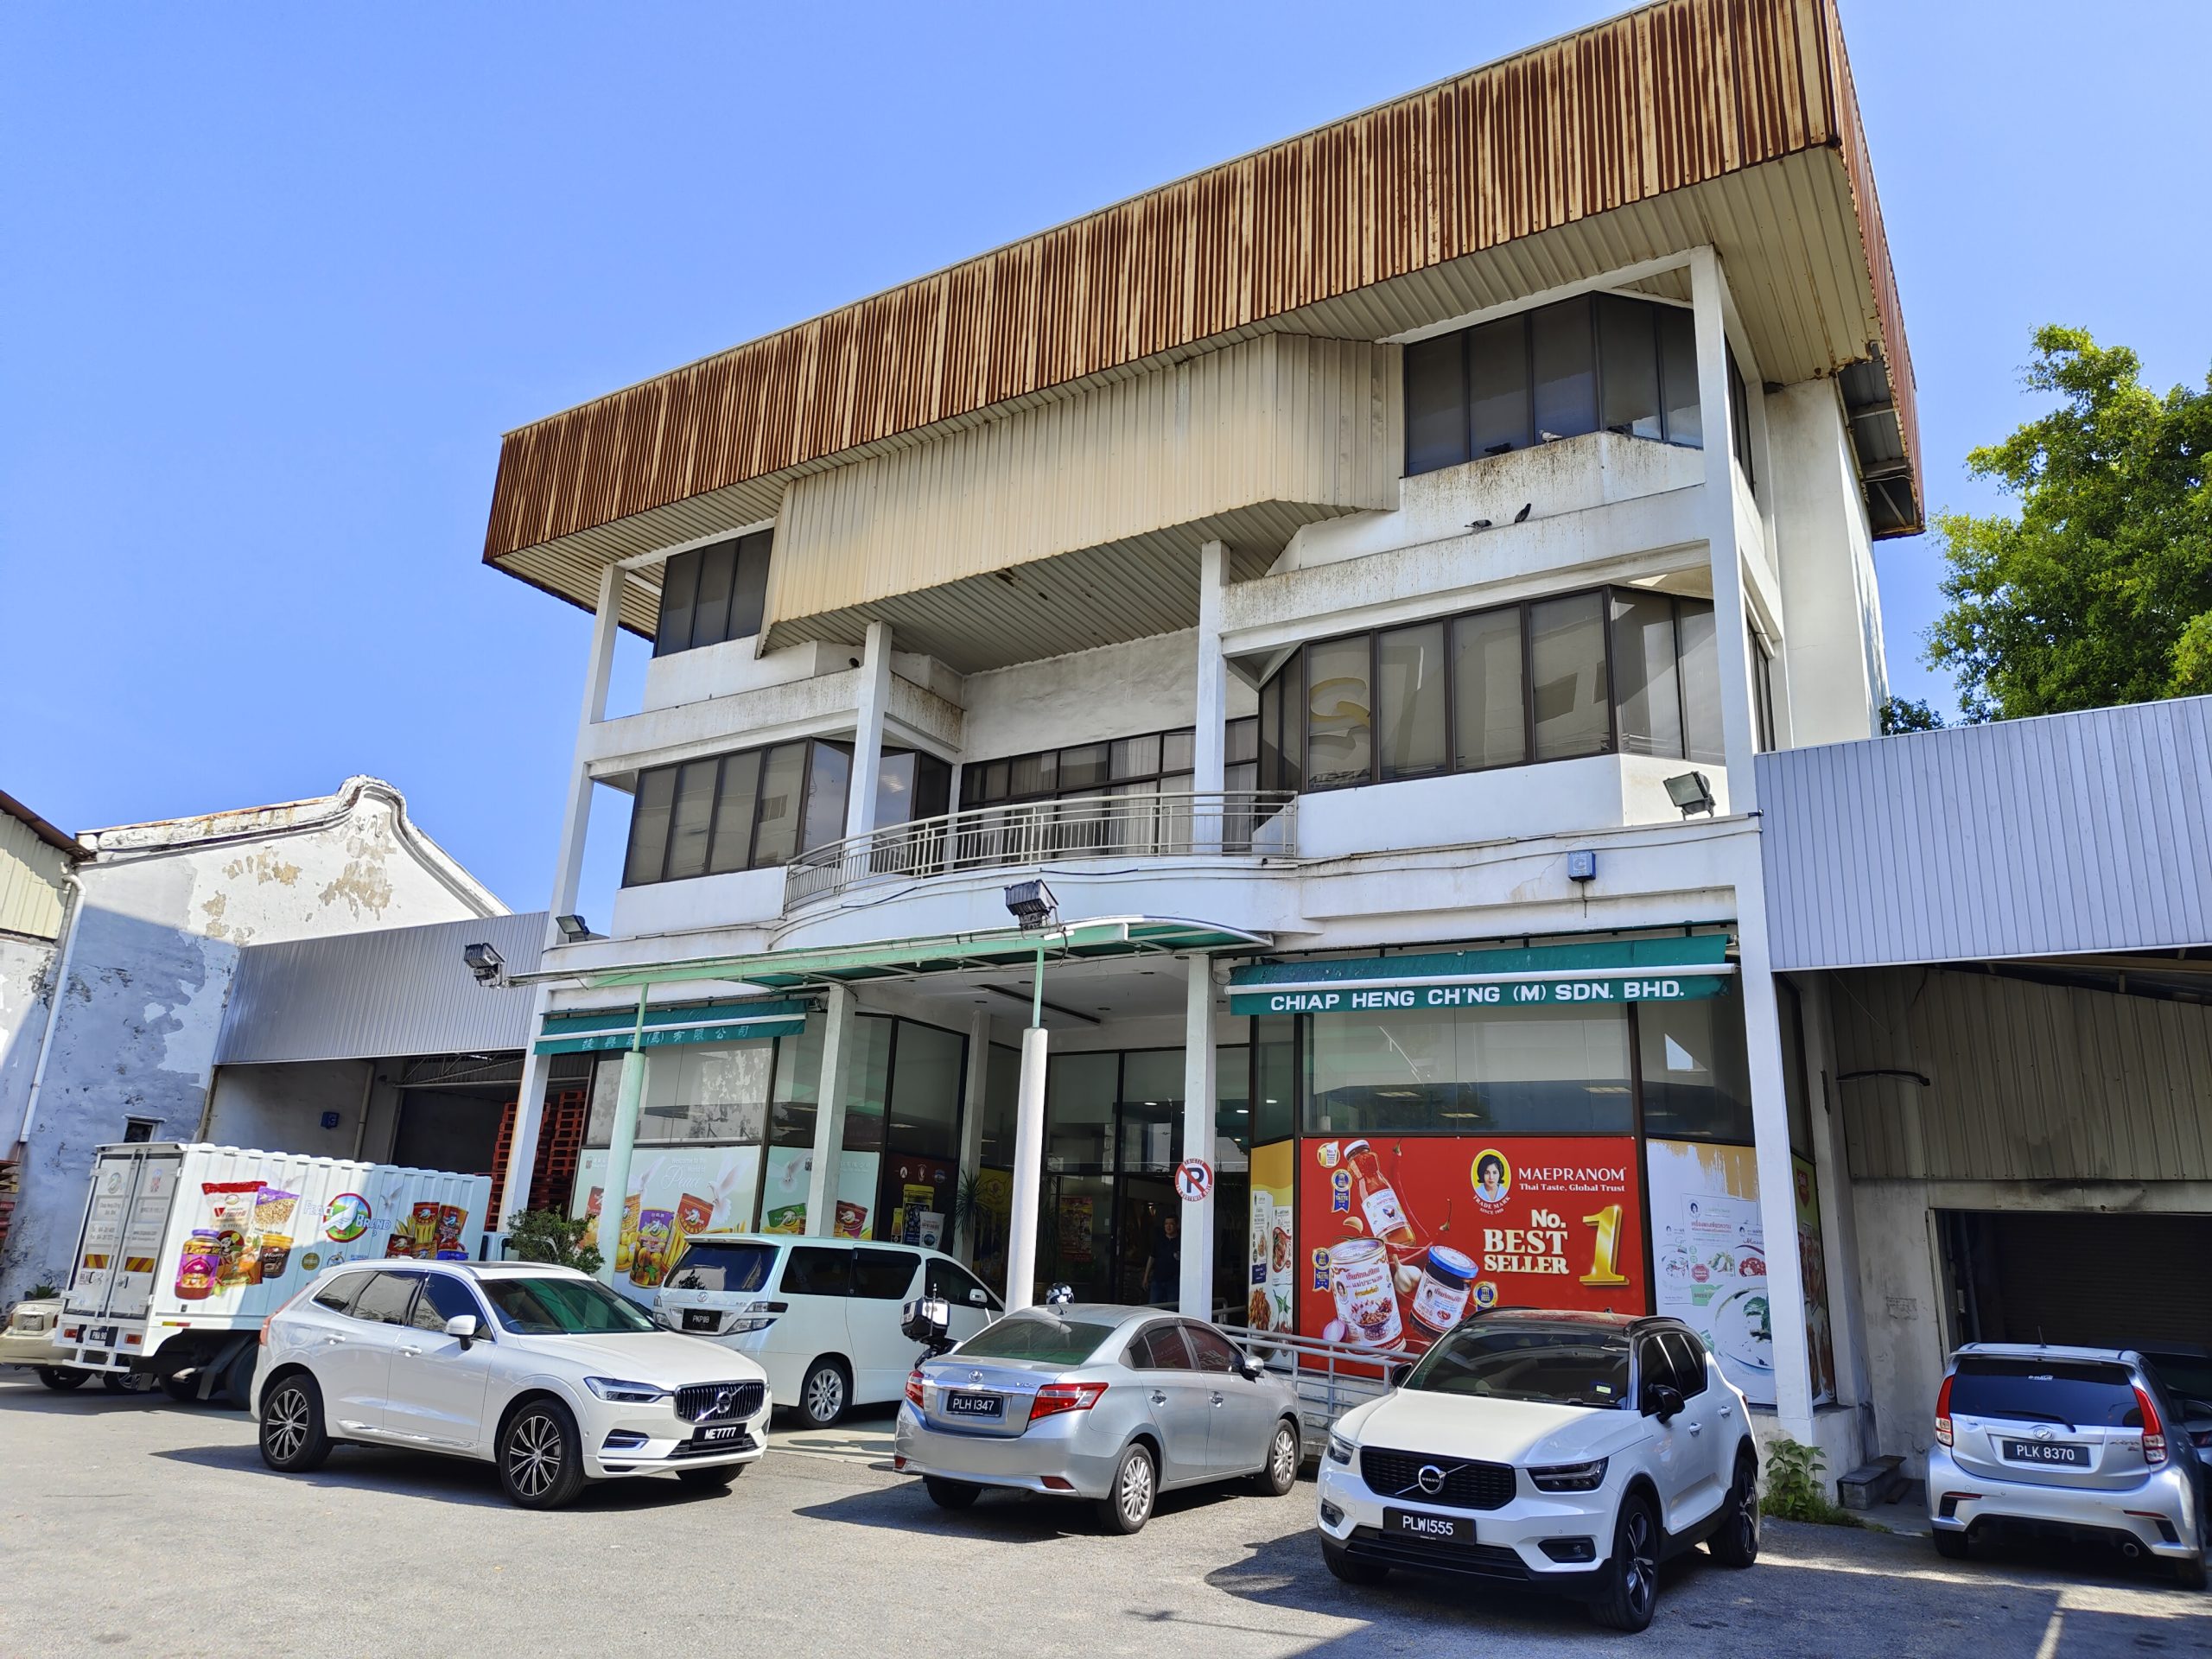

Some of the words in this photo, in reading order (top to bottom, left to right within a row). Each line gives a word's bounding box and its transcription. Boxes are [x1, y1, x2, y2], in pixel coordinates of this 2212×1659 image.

[1270, 994, 1339, 1011] CHIAP
[1351, 990, 1415, 1008] HENG
[1427, 987, 1500, 1005] CH'NG
[1513, 985, 1547, 1002] (M)
[1555, 982, 1614, 1001] SDN.
[1624, 980, 1685, 999] BHD.
[661, 1165, 700, 1190] Peace
[1186, 1167, 1205, 1193] P
[1518, 1167, 1625, 1181] MAEPRANOM
[1472, 1194, 1492, 1209] TRADE
[1493, 1195, 1511, 1209] MARK
[356, 1213, 392, 1230] BRAND
[1530, 1209, 1567, 1228] No.
[1483, 1229, 1568, 1255] BEST
[1580, 1205, 1630, 1286] 1
[1484, 1255, 1570, 1274] SELLER
[952, 1398, 972, 1410] PLH
[973, 1399, 995, 1411] 1347
[2017, 1445, 2041, 1458] PLK
[2044, 1447, 2075, 1461] 8370
